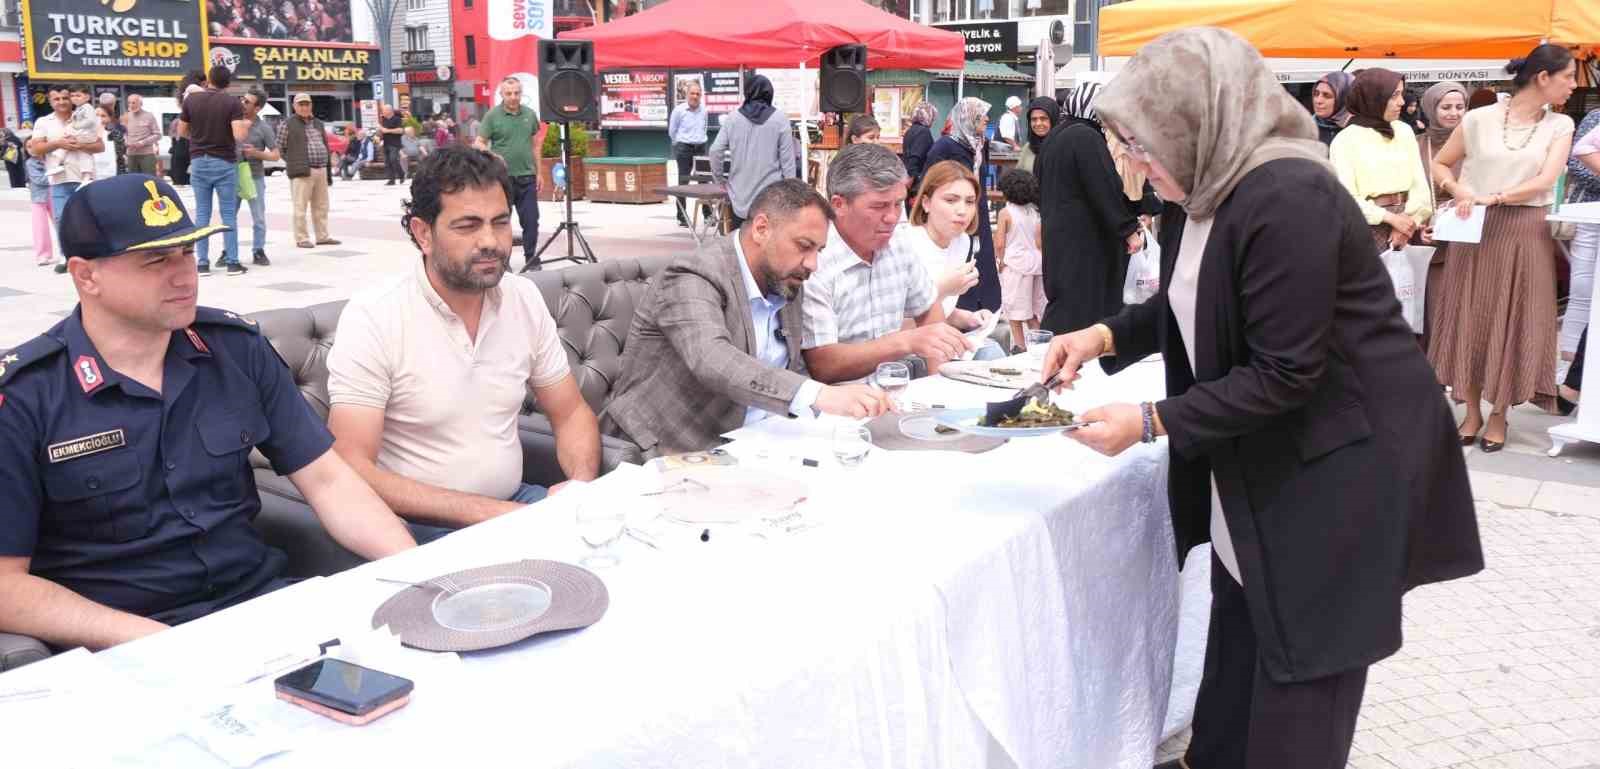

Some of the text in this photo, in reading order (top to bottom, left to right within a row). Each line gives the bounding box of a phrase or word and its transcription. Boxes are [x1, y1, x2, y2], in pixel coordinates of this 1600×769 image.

[48, 13, 188, 39] TURKCELL
[66, 38, 189, 58] CEP SHOP
[254, 47, 369, 64] ŞAHANLAR
[133, 58, 180, 68] MAĞAZASI
[261, 62, 365, 81] ET DÖNER
[604, 74, 633, 84] VESTEL
